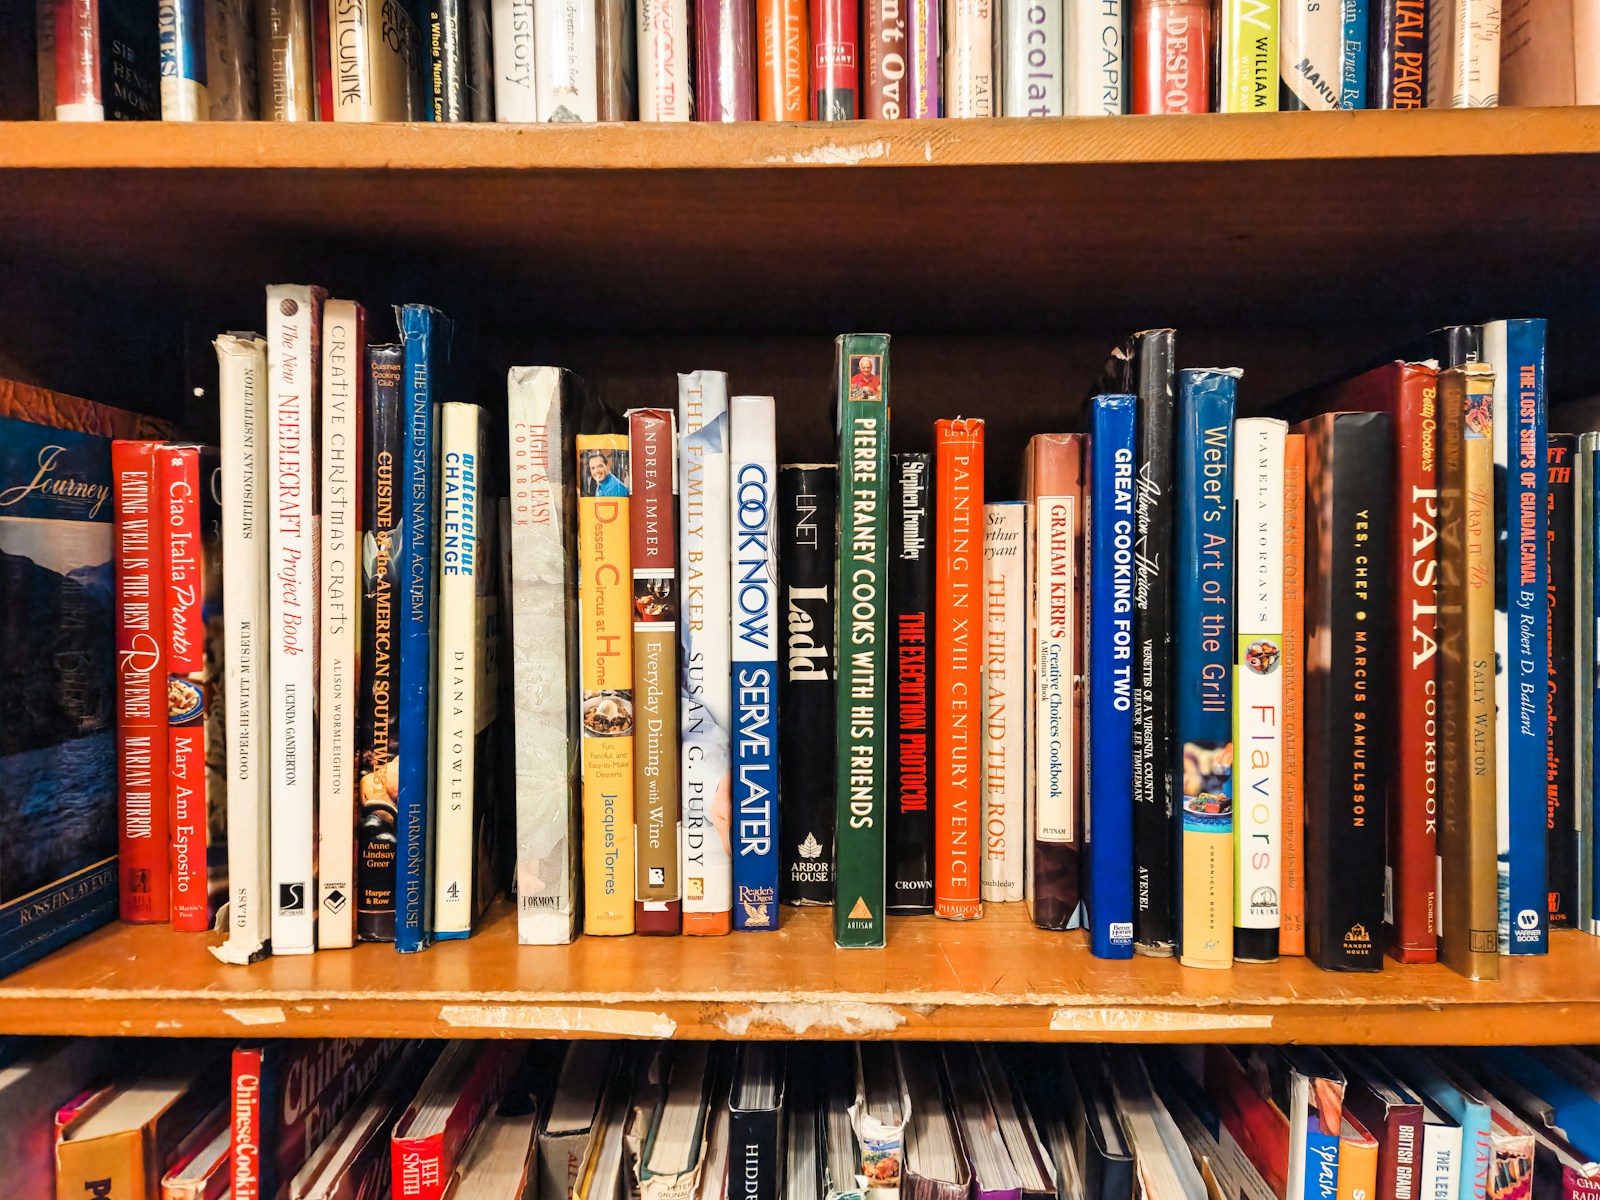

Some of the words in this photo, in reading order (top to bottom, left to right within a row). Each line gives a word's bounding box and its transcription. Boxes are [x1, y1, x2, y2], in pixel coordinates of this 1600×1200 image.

[431, 23, 441, 56] Whole
[786, 15, 800, 111] LINCOLN'S
[1345, 40, 1361, 83] Ernest
[1255, 37, 1267, 107] WILLIAM
[282, 324, 299, 354] The
[282, 356, 298, 384] New
[415, 363, 426, 389] THE
[1520, 364, 1535, 389] THE
[244, 368, 254, 448] INSTITUTION
[414, 392, 427, 446] UNITED
[687, 384, 702, 434] THE
[1421, 386, 1436, 418] Betty
[1520, 391, 1536, 425] LOST
[278, 394, 301, 538] NEEDLECRAFT
[530, 425, 549, 468] LIGHT
[644, 420, 656, 490] ANDREA
[854, 419, 876, 482] PIERRE
[1259, 431, 1268, 509] PAMELA
[1421, 419, 1434, 472] Crocker's
[1520, 429, 1536, 468] SHIPS
[0, 445, 110, 519] Journey
[122, 471, 148, 513] EATING
[242, 453, 254, 539] SMITHSONIAN
[377, 451, 392, 527] CUISINE
[413, 450, 425, 499] STATES
[515, 423, 528, 526] COOKBOOK
[687, 445, 703, 541] FAMILY
[899, 462, 924, 507] Stephen
[1114, 448, 1132, 514] GREAT
[1136, 461, 1161, 534] Arlington
[1203, 426, 1227, 522] Weber's
[1520, 472, 1536, 488] OF
[170, 481, 192, 526] Ciao
[412, 503, 424, 550] NAVAL
[444, 453, 458, 575] CHALLENGE
[461, 453, 475, 575] watercolour
[531, 490, 550, 527] EASY
[646, 498, 658, 556] IMMER
[737, 464, 767, 551] COOK
[796, 494, 817, 550] LINET
[853, 490, 875, 563] FRANEY
[953, 456, 969, 570] PAINTING
[1354, 510, 1368, 548] YES,
[122, 520, 148, 553] WELL
[171, 532, 192, 581] Italia
[594, 501, 619, 561] Dessert
[899, 508, 925, 561] Trombley
[1050, 505, 1067, 576] GRAHAM
[1203, 533, 1226, 569] Art
[1520, 492, 1536, 586] GUADALCANAL
[123, 558, 149, 568] IS
[123, 574, 149, 597] THE
[277, 546, 302, 606] Project
[411, 553, 424, 623] ACADEMY
[1113, 520, 1132, 613] COOKING
[1135, 535, 1160, 609] Heritage
[1259, 522, 1268, 622] MORGAN'S
[1355, 556, 1368, 600] CHEF
[123, 602, 150, 630] BEST
[595, 564, 620, 616] Circus
[687, 550, 703, 632] BAKER
[738, 559, 769, 650] NOW
[850, 569, 876, 644] COOKS
[953, 583, 968, 608] IN
[988, 575, 1006, 622] THE
[1050, 583, 1067, 639] KERR'S
[1203, 580, 1225, 604] of
[1517, 590, 1534, 609] By
[172, 584, 195, 662] Pronto!
[240, 621, 250, 674] MUSEUM
[282, 612, 303, 656] Book
[376, 579, 391, 677] AMERICAN
[787, 583, 828, 682] Ladd
[899, 612, 925, 643] THE
[952, 618, 967, 670] XVIII
[1114, 620, 1130, 660] FOR
[1202, 614, 1222, 652] the
[1520, 614, 1535, 655] Robert
[119, 633, 159, 718] REVENGE
[333, 659, 342, 700] ALISON
[596, 635, 621, 685] Home
[643, 643, 663, 712] Everyday
[852, 652, 874, 699] WITH
[988, 630, 1006, 680] FIRE
[1049, 644, 1061, 690] Creative
[1143, 639, 1153, 687] VIGNETTES
[1355, 631, 1366, 702] MARCUS
[1412, 486, 1438, 670] PASTA
[1425, 679, 1436, 835] COOKBOOK
[1521, 660, 1534, 676] D.
[285, 684, 296, 725] LUCINDA
[453, 652, 464, 716] DIANA
[688, 652, 703, 734] SUSAN
[899, 646, 926, 728] EXECUTION
[1041, 684, 1049, 702] Book
[1114, 666, 1130, 711] TWO
[1202, 664, 1225, 712] Grill
[1473, 660, 1487, 705] SALLY
[239, 676, 250, 780] COOPER-HEWITT
[739, 669, 770, 757] SERVE
[852, 707, 874, 738] HIS
[988, 688, 1006, 740] AND
[1050, 693, 1062, 737] Choices
[1520, 683, 1535, 736] Ballard
[125, 736, 151, 786] MARIAN
[172, 738, 194, 779] Mary
[285, 728, 296, 786] GANDERTON
[332, 704, 341, 795] WORMLEIGHTON
[644, 718, 663, 776] Dining
[688, 746, 703, 769] G.
[951, 682, 967, 790] CENTURY
[1143, 715, 1153, 759] VIRGINIA
[1474, 714, 1488, 776] WALTON
[451, 730, 463, 811] VOWLES
[649, 781, 660, 803] with
[852, 746, 873, 829] FRIENDS
[900, 734, 927, 813] PROTOCOL
[988, 746, 1006, 794] THE
[1050, 740, 1062, 798] Cookbook
[1144, 762, 1154, 803] COUNTY
[1251, 706, 1275, 870] Flavors
[1353, 712, 1366, 827] SAMUELSSON
[125, 792, 151, 838] BURROS
[176, 785, 193, 819] Ann
[601, 793, 618, 847] Jacques
[688, 781, 703, 867] PURDY
[739, 764, 771, 856] LATER
[407, 803, 420, 876] HARMONY
[649, 810, 663, 848] Wine
[951, 800, 967, 887] VENICE
[987, 798, 1006, 861] ROSE
[173, 825, 196, 892] Esposito
[605, 848, 618, 894] Torres
[791, 863, 829, 871] ARBOR
[791, 873, 828, 882] HOUSE
[238, 888, 247, 927] GLASS
[406, 880, 419, 928] HOUSE
[895, 881, 932, 889] CROWN
[1138, 866, 1149, 911] AVENEL
[1397, 1125, 1414, 1163] BRITISH
[1436, 1150, 1450, 1171] THE
[402, 1153, 420, 1195] SMITH
[419, 1156, 439, 1188] JEFF
[1310, 1146, 1339, 1199] splash
[1395, 1166, 1413, 1200] GRAND
